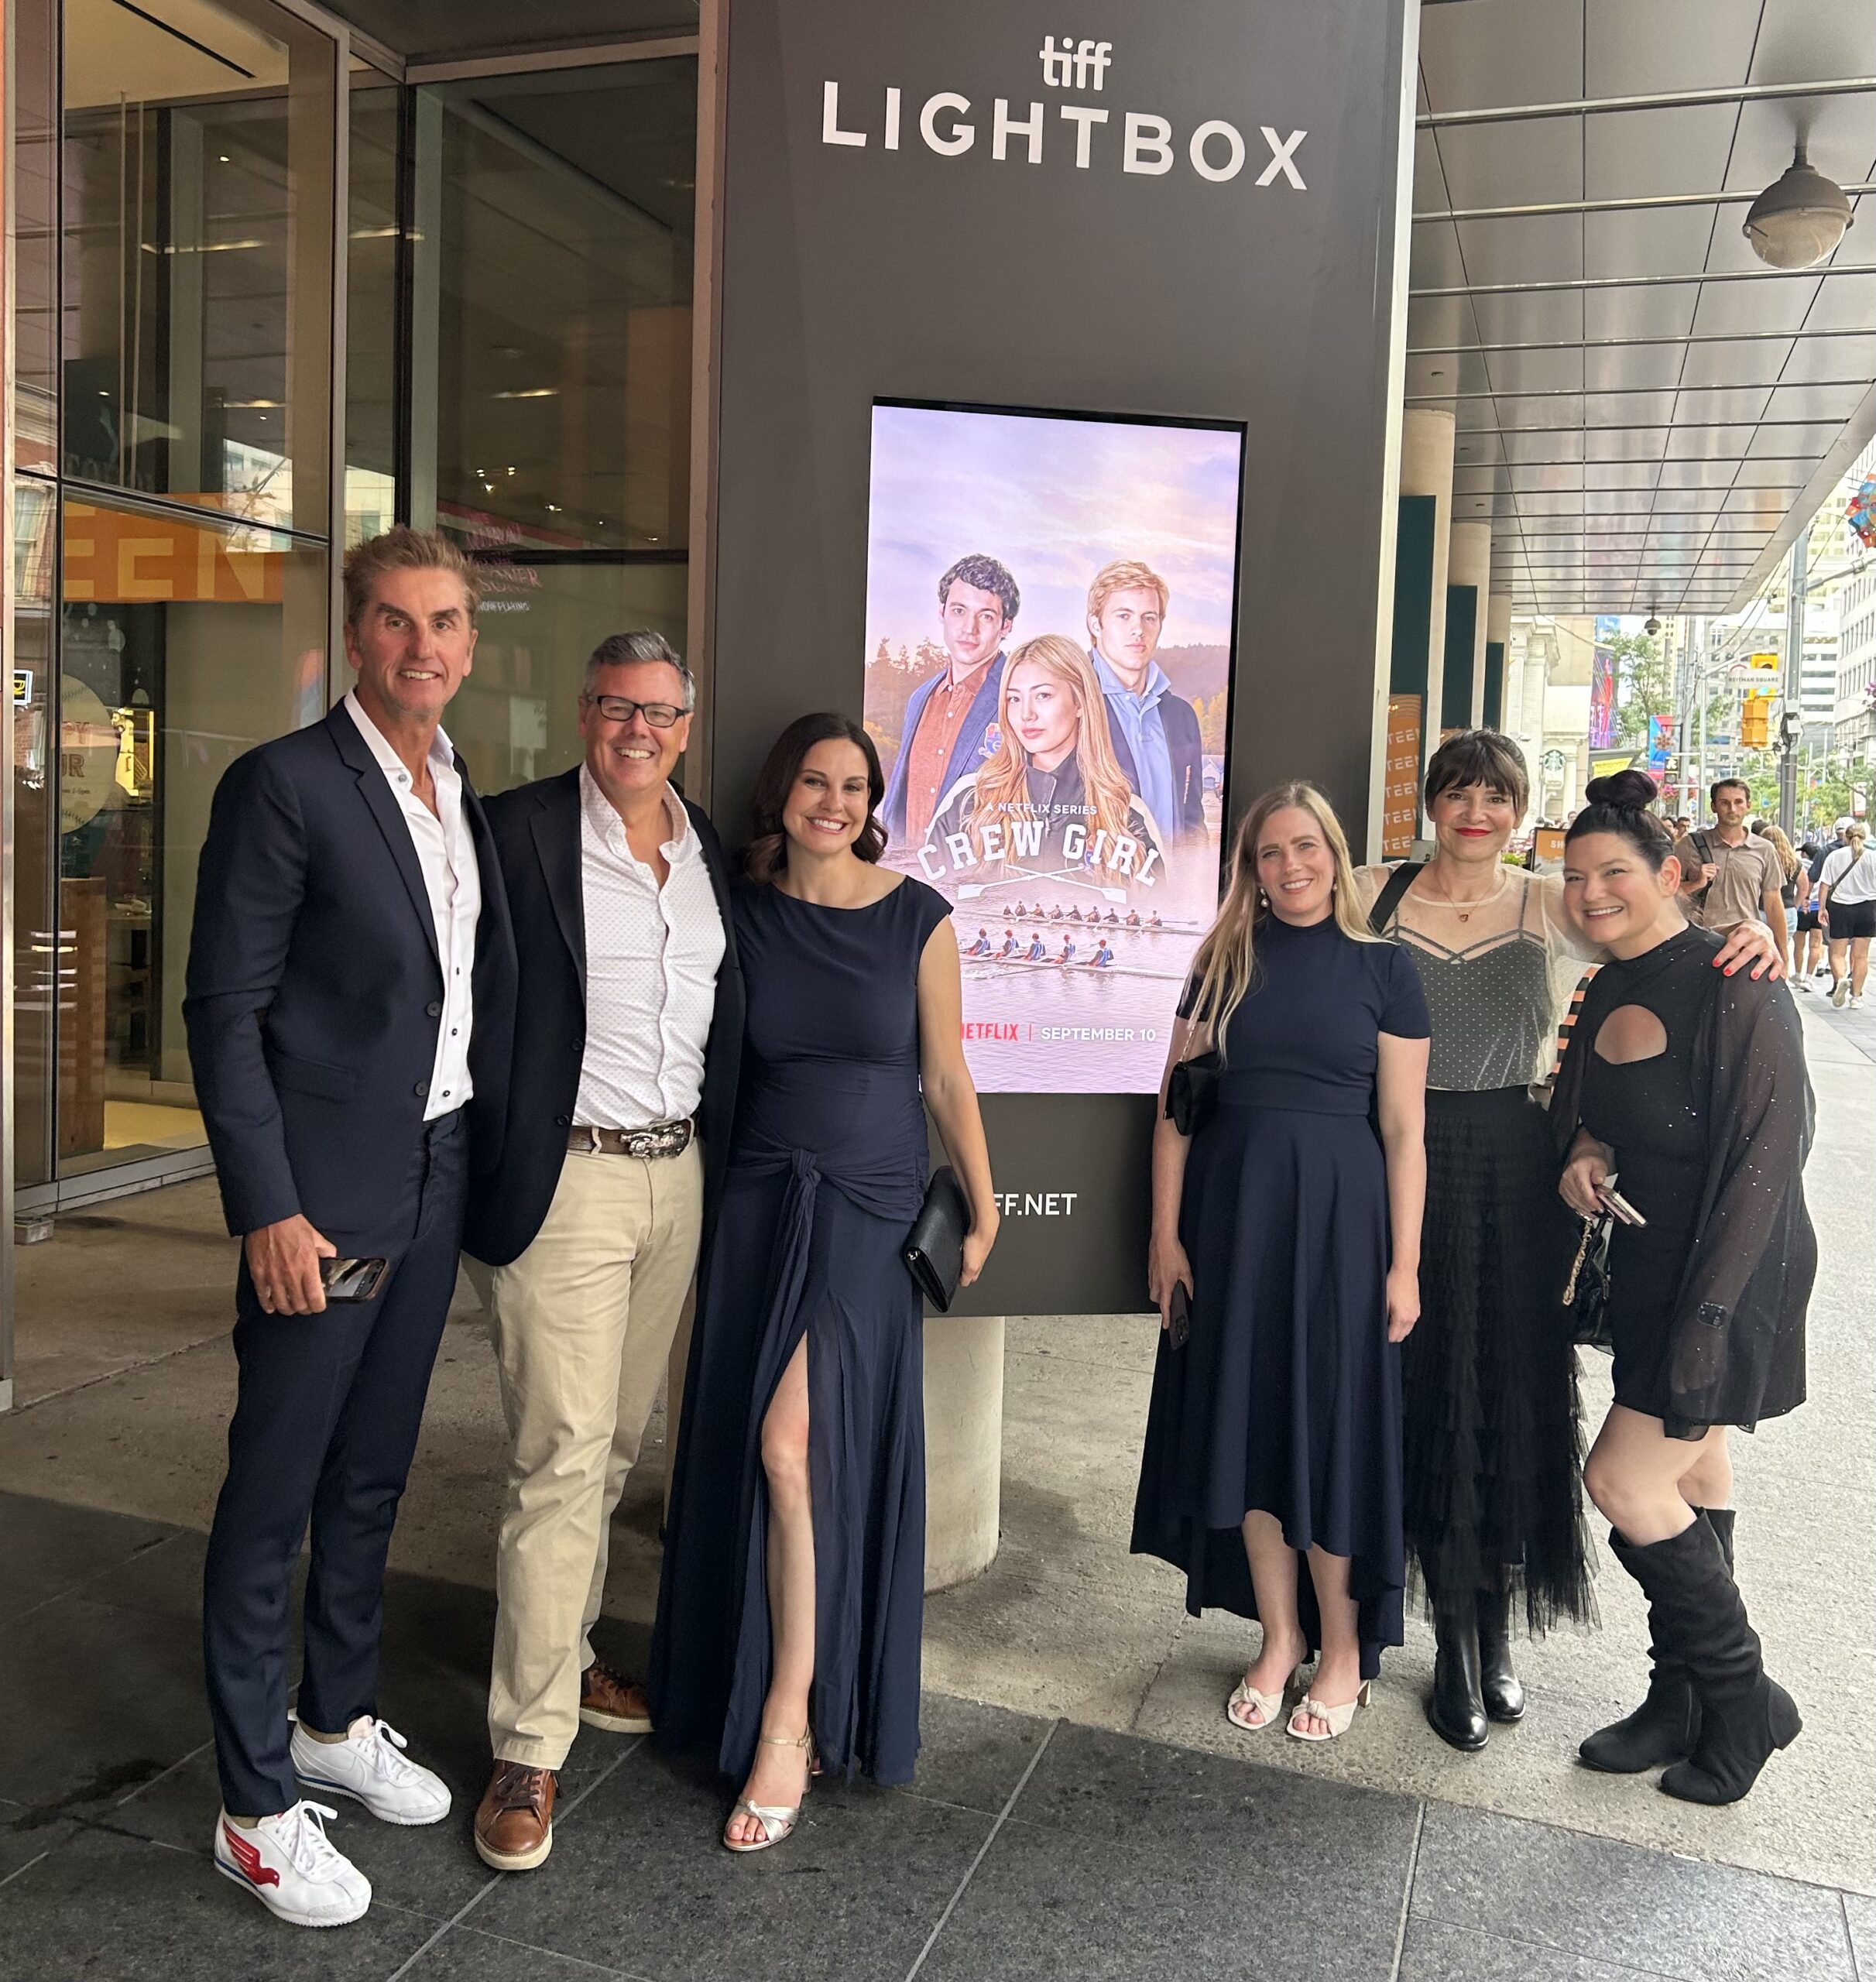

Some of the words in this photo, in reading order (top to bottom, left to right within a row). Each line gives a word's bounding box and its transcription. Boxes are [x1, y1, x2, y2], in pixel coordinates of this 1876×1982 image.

[1039, 36, 1113, 91] tiff
[822, 81, 1308, 190] LIGHTBOX
[986, 802, 994, 812] A
[997, 802, 1051, 814] NETFLIX
[1053, 804, 1098, 815] SERIES
[917, 821, 1044, 880] CREW
[1062, 823, 1161, 887] GIRL
[1041, 1027, 1134, 1041] SEPTEMBER
[1139, 1028, 1156, 1041] 10
